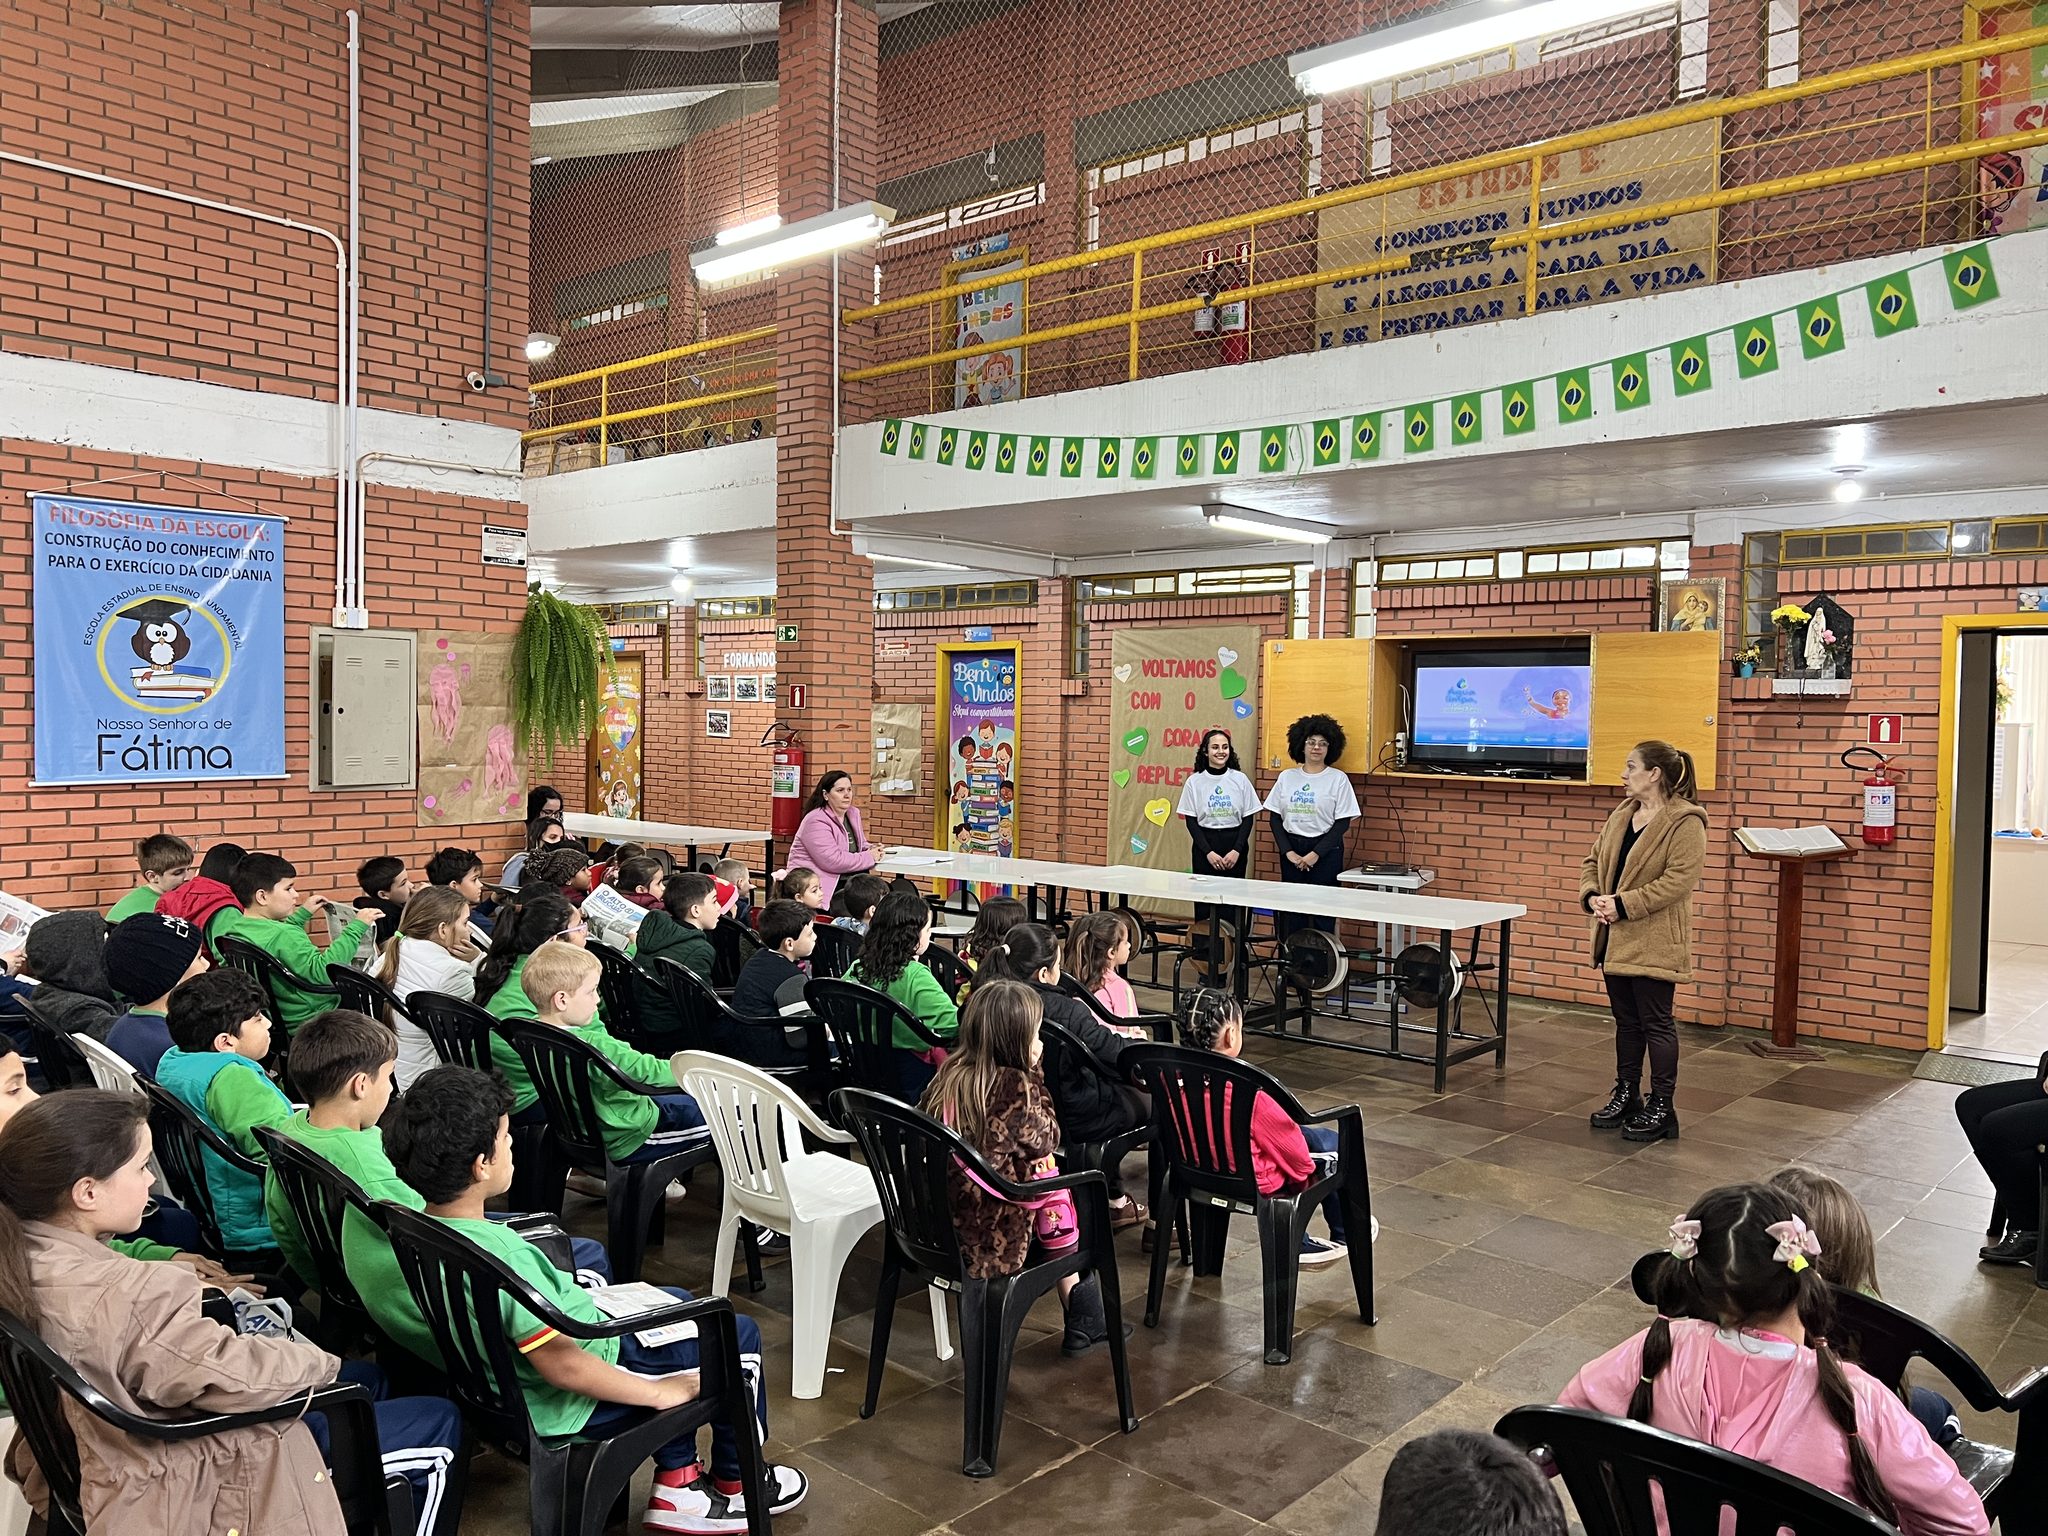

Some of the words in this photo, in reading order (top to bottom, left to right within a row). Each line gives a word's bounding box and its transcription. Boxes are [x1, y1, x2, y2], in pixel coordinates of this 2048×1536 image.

[1374, 211, 1509, 252] CONHECER
[1343, 296, 1358, 314] E
[1369, 272, 1492, 309] ALEGRIAS
[1500, 267, 1520, 286] A
[1599, 278, 1622, 298] A
[1630, 262, 1706, 292] VIDA
[962, 286, 999, 308] BEM
[49, 506, 156, 532] FILOSOFIA
[160, 517, 190, 534] DA
[195, 521, 271, 543] ESCOLA:
[44, 532, 142, 554] CONSTRUÇÃO
[146, 541, 167, 555] DO
[170, 542, 275, 562] CONHECIMENTO
[48, 555, 86, 570] PARA
[90, 557, 101, 571] O
[105, 558, 175, 576] EXERCÍCIO
[179, 564, 198, 578] DA
[201, 565, 272, 582] CIDADANIA
[83, 611, 106, 646] ESCOLA
[101, 585, 147, 613] ESTADUAL
[148, 583, 162, 592] DE
[164, 583, 200, 599] ENSINO
[204, 596, 243, 651] UNDAMENTAL
[723, 651, 777, 669] FORMANDO
[1141, 658, 1217, 678] VOLTAMOS
[953, 662, 994, 683] Bem
[964, 681, 1015, 703] Vindos
[1130, 691, 1161, 710] COM
[1184, 691, 1196, 710] O
[97, 718, 144, 730] Nossa
[149, 718, 208, 730] Senhora
[213, 718, 232, 730] de
[1163, 725, 1232, 747] CORA
[97, 733, 233, 772] Fátima
[1137, 765, 1194, 787] REPLET
[607, 896, 627, 910] ALTO
